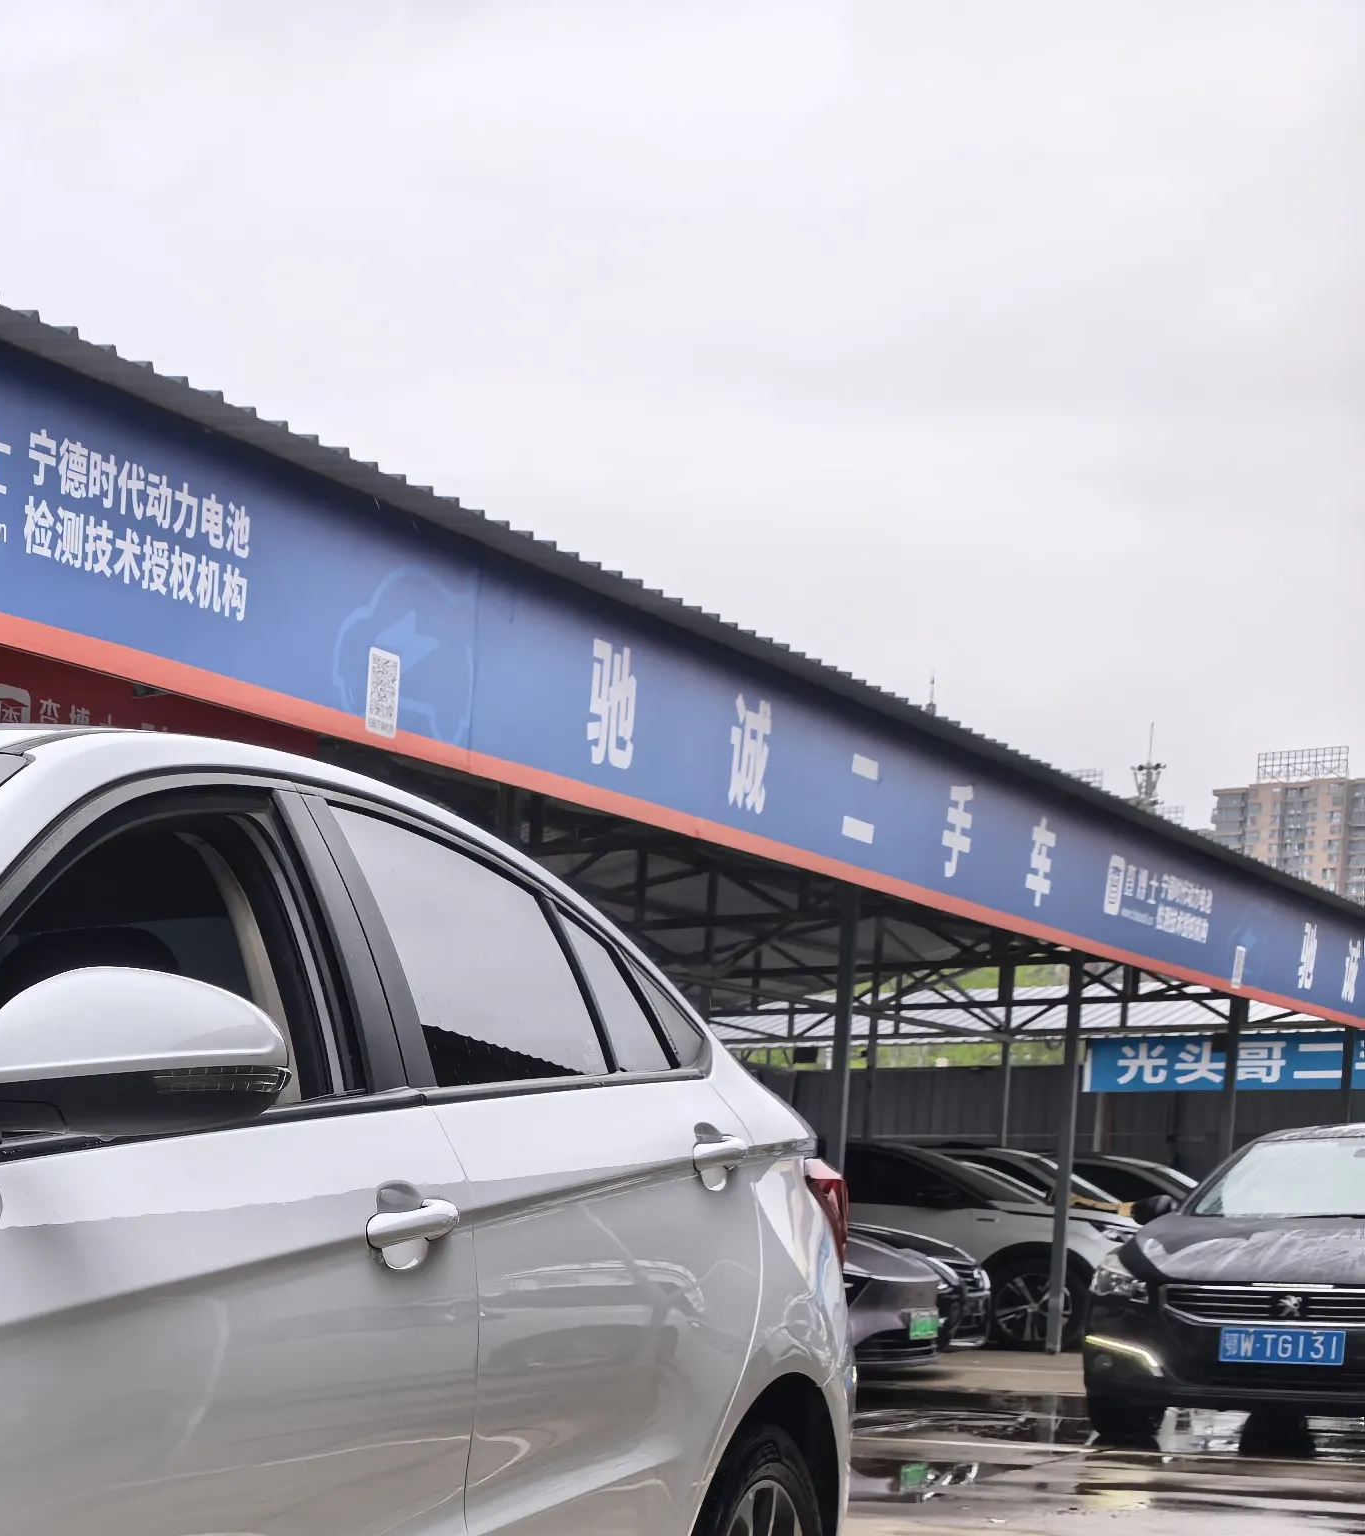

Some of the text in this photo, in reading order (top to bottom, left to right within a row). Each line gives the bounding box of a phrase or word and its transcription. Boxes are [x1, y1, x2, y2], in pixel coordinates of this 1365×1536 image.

[28, 429, 251, 558] 宁德时代动力电池
[23, 495, 248, 621] 检测技术授权机构
[1117, 1040, 1365, 1084] 光头哥二
